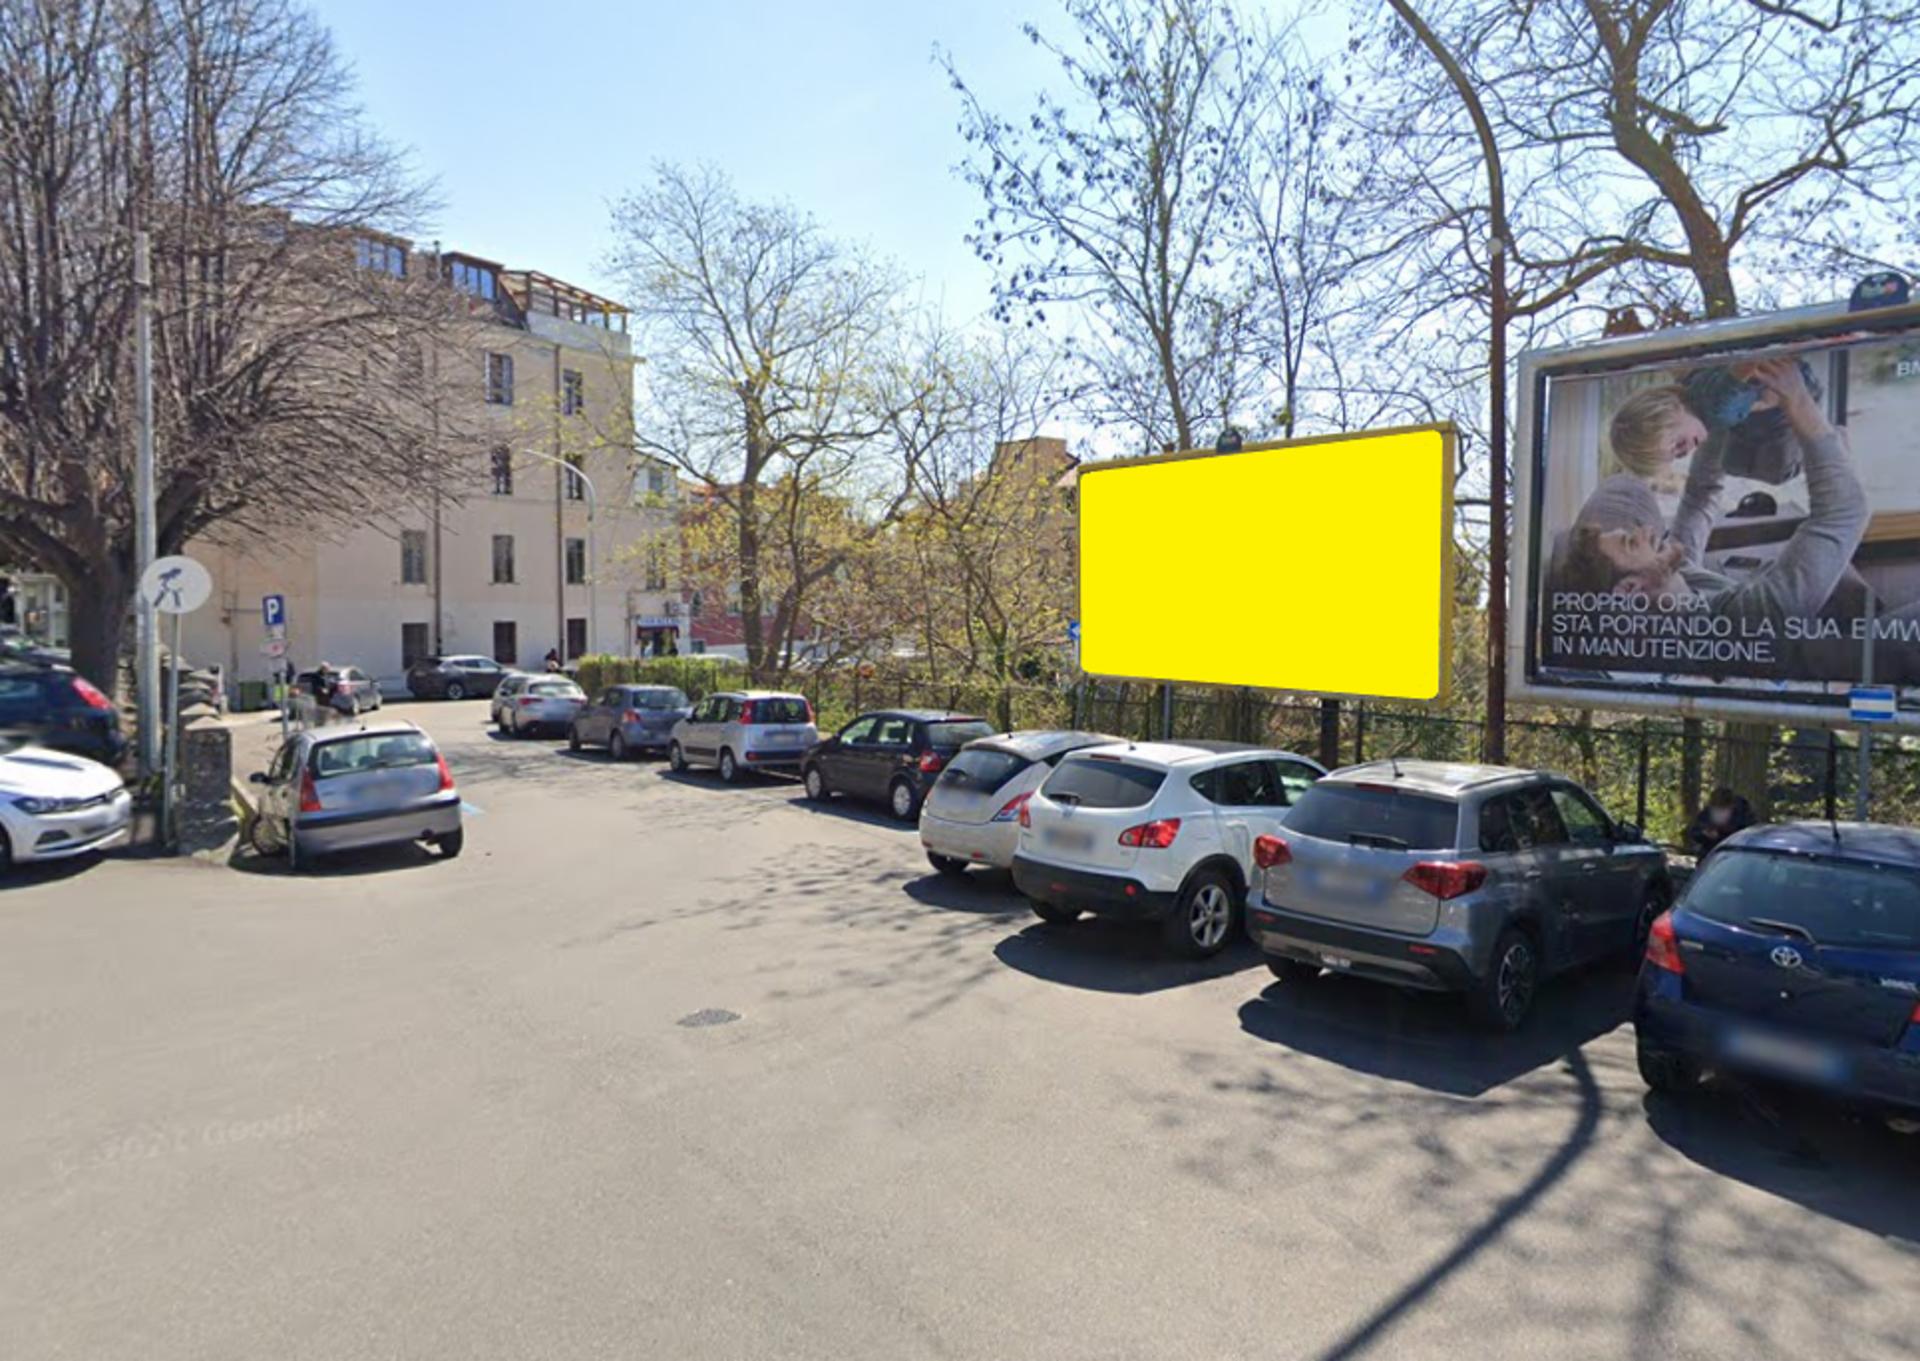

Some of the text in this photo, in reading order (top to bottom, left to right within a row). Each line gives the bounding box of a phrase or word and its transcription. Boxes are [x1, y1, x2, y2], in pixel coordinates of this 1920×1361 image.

[266, 598, 279, 623] P
[1552, 592, 1711, 613] PROPRIO ORA
[1552, 614, 1593, 633] STA
[1600, 614, 1732, 637] PORTANDO
[1741, 617, 1776, 639] LA
[1784, 616, 1842, 640] SUA
[1553, 636, 1776, 663] IN MANUTENZIONE.
